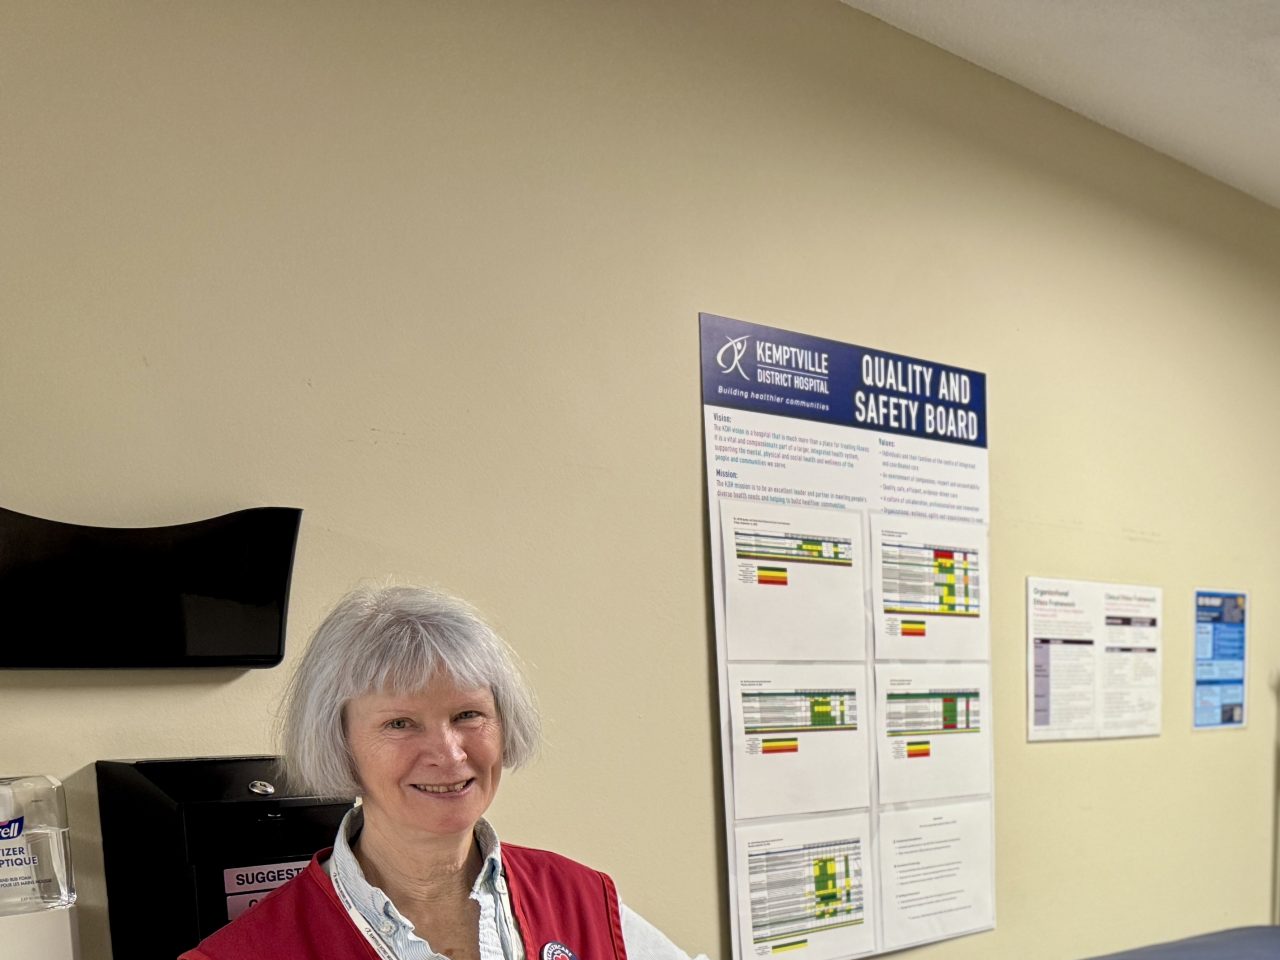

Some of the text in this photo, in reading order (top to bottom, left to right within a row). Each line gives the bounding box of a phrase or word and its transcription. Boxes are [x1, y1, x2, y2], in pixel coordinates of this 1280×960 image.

[756, 341, 829, 374] KEMPTVILLE
[757, 369, 830, 395] DISTRICT HOSPITAL
[862, 354, 971, 404] QUALITY AND
[718, 385, 830, 411] Building healthier communities
[855, 391, 978, 440] SAFETY BOARD
[716, 469, 738, 479] Mission:
[0, 847, 25, 857] IZER
[236, 867, 305, 886] SUGGEST
